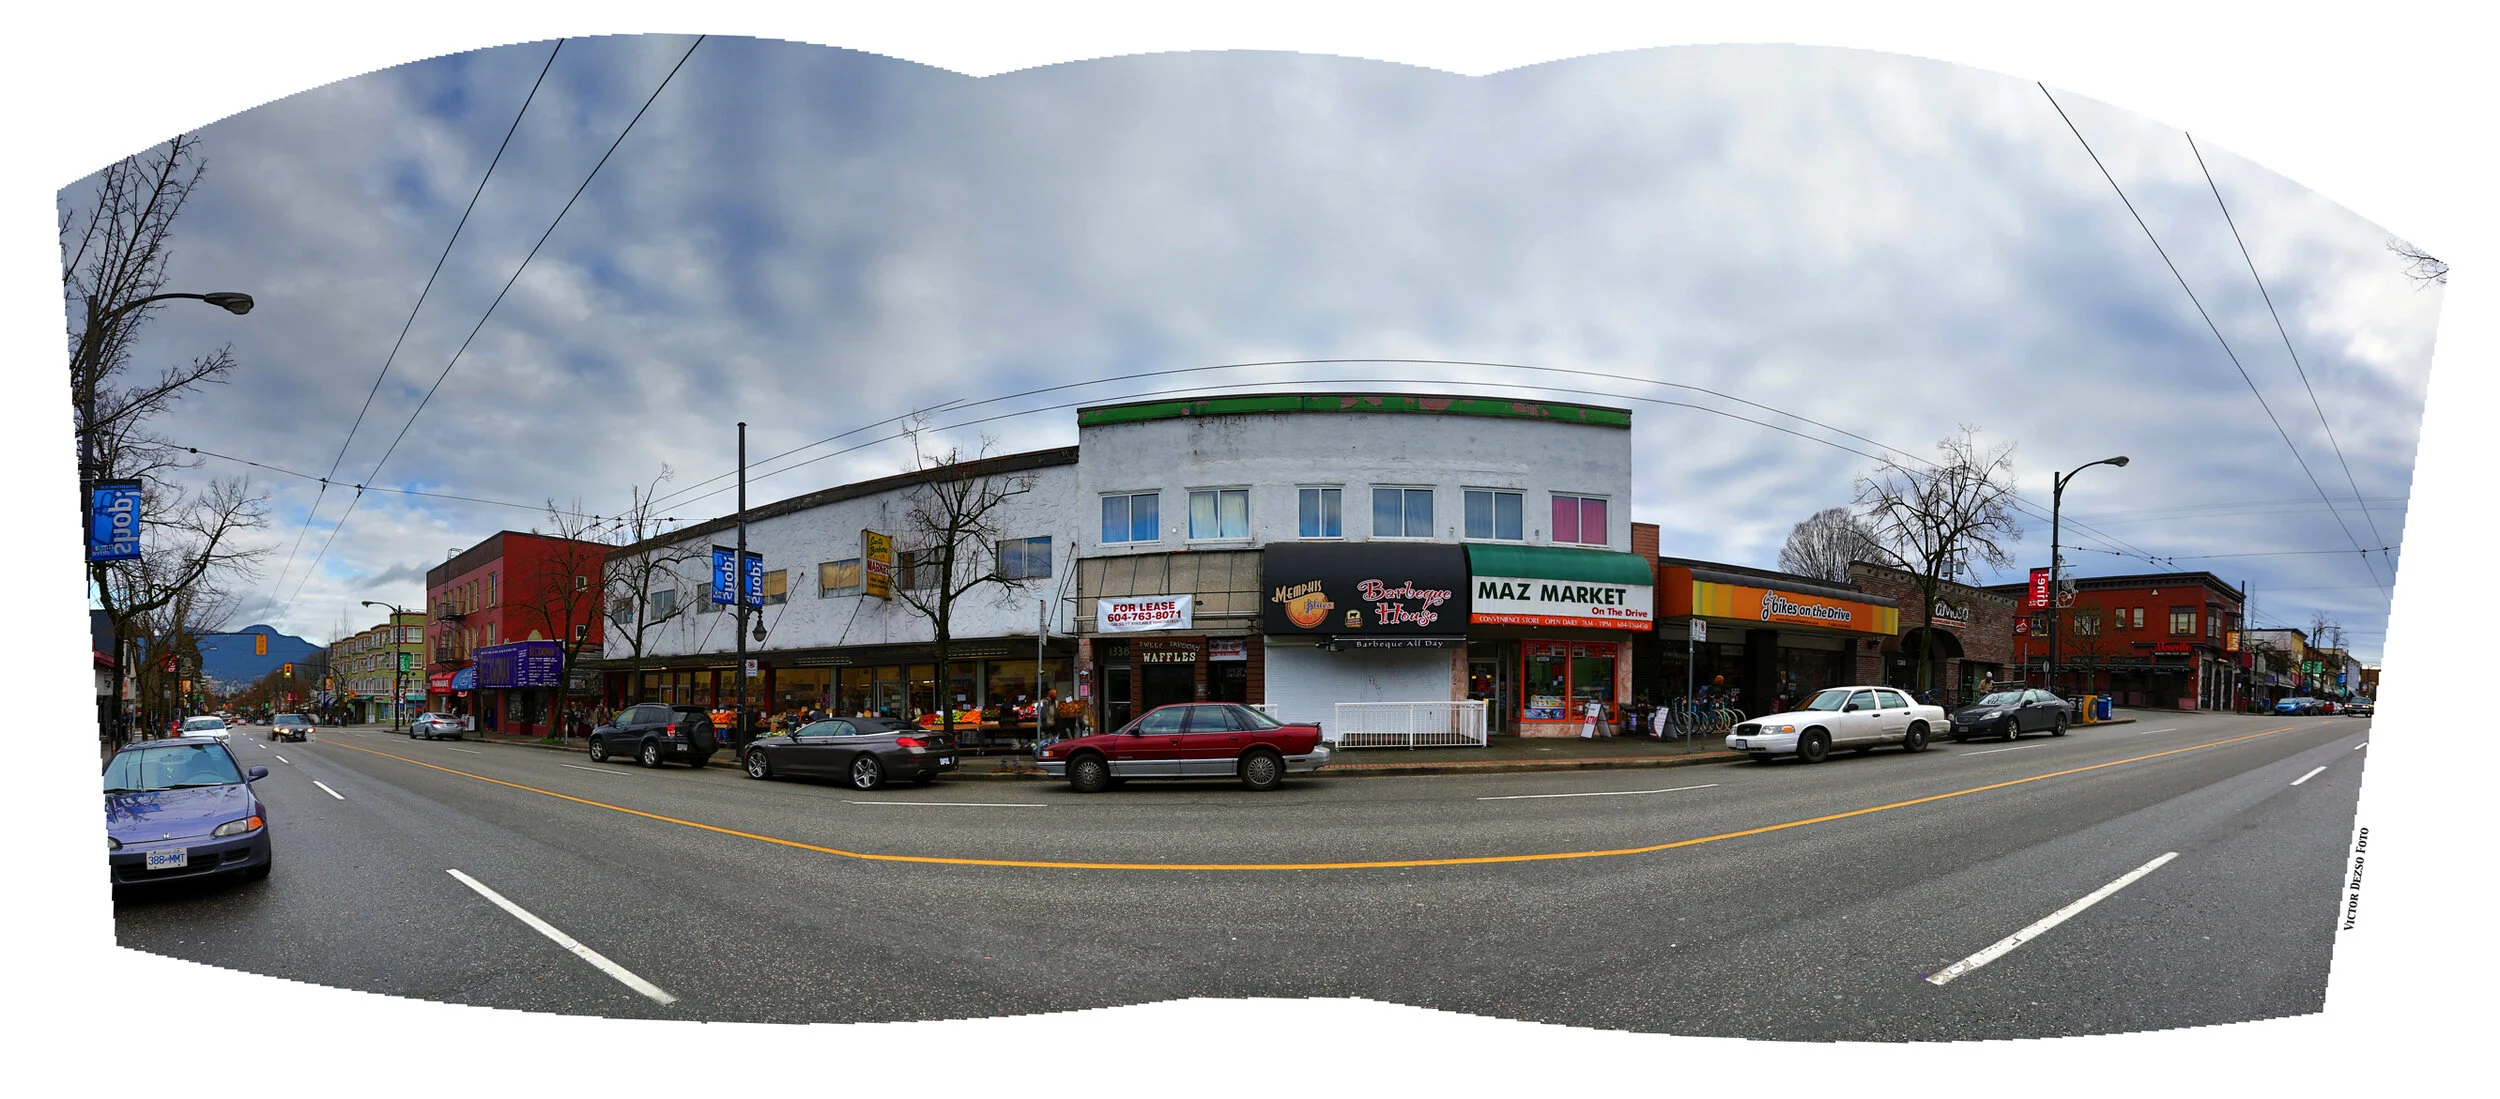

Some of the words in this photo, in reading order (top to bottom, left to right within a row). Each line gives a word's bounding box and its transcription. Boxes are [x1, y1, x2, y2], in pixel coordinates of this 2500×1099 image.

[1357, 578, 1452, 610] Barbeque
[1478, 581, 1531, 601] MAZ
[1540, 584, 1627, 606] MARKET
[1113, 603, 1136, 613] FOR
[1139, 601, 1176, 612] LEASE
[1305, 598, 1333, 614] Blues
[1591, 606, 1605, 616] On
[1607, 607, 1623, 617] The
[1625, 608, 1648, 618] Drive
[1771, 598, 1798, 615] bikes
[1799, 606, 1811, 616] on
[1812, 605, 1827, 618] the
[1827, 608, 1851, 620] Drive
[1107, 610, 1182, 622] 604-763-8071
[1374, 602, 1438, 627] House
[1479, 615, 1521, 624] CONVENIENCE
[1522, 617, 1540, 625] STORE
[1545, 618, 1561, 626] OPEN
[1562, 618, 1578, 626] DAILY
[1356, 641, 1403, 649] Barbeque
[1425, 640, 1443, 648] Day
[1143, 652, 1196, 662] WAFFLES
